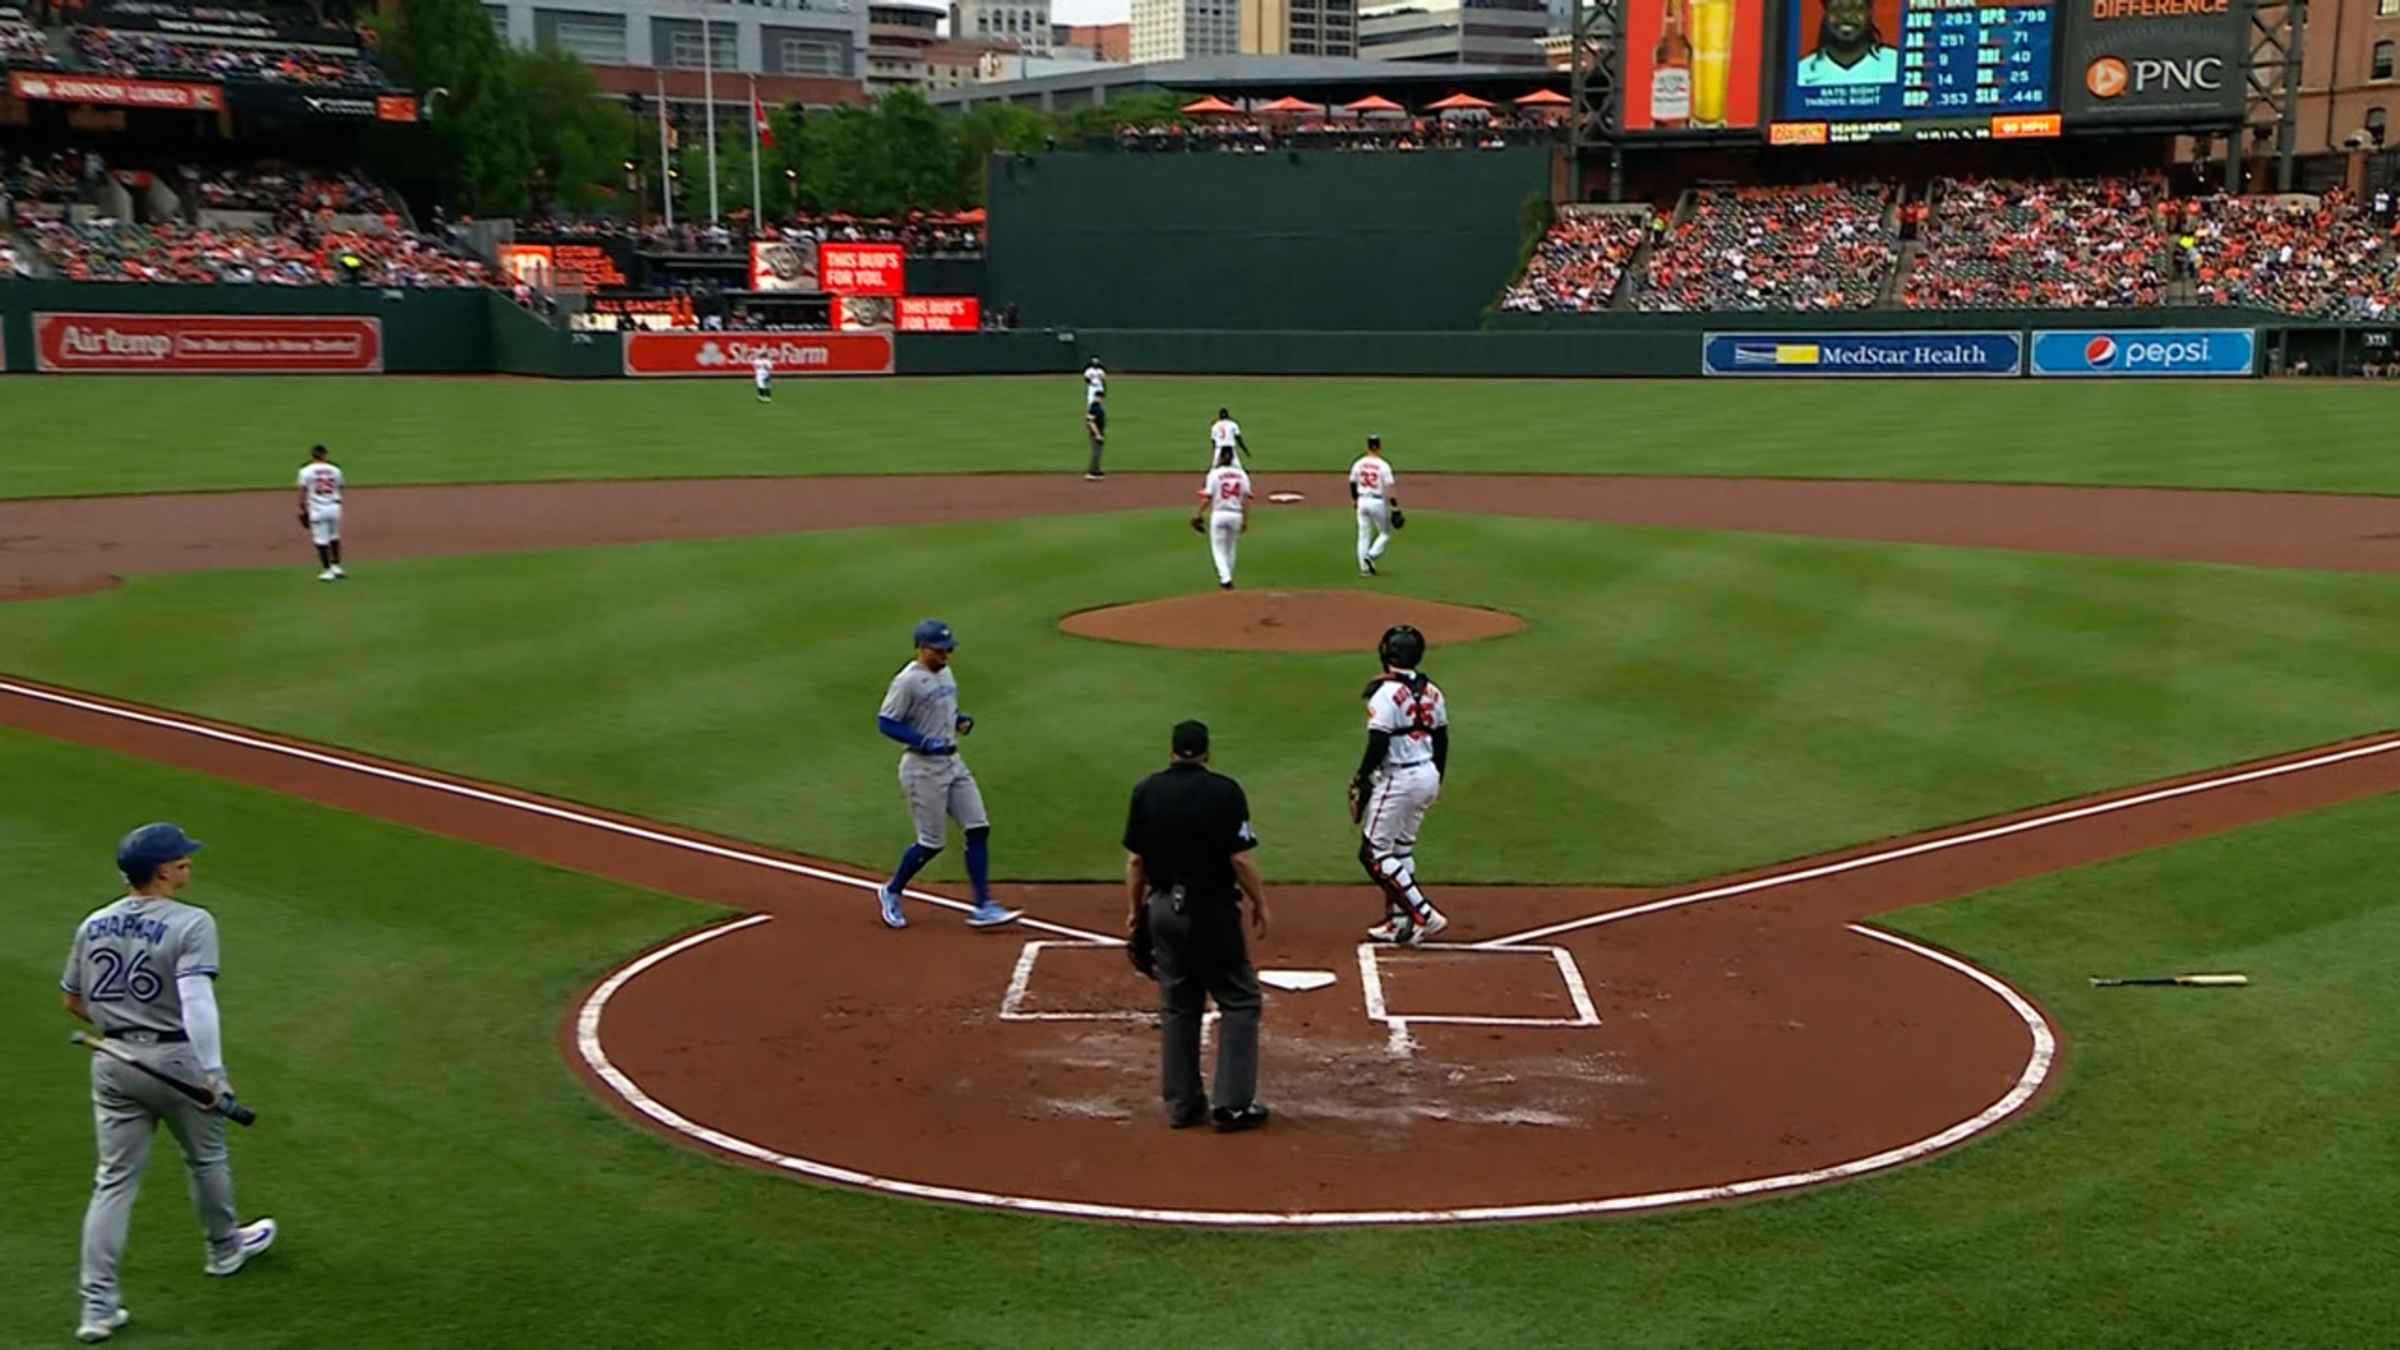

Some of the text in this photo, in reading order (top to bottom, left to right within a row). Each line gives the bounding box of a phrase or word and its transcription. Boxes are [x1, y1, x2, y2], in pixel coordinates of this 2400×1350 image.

[2013, 31, 2029, 44] 71
[2011, 50, 2031, 63] 40
[1938, 73, 1953, 86] 14
[2010, 69, 2030, 83] 25
[2132, 56, 2222, 91] PNC
[826, 252, 899, 269] THIS BUD'S
[826, 270, 854, 286] FOR
[901, 301, 928, 315] THIS
[63, 325, 172, 358] Airtemp
[1822, 344, 1987, 365] MedStar Health
[2126, 337, 2210, 368] pepsi
[1359, 470, 1379, 489] 32
[1221, 481, 1241, 500] 64
[87, 912, 168, 945] CHAPMAN
[89, 946, 163, 1002] 26
